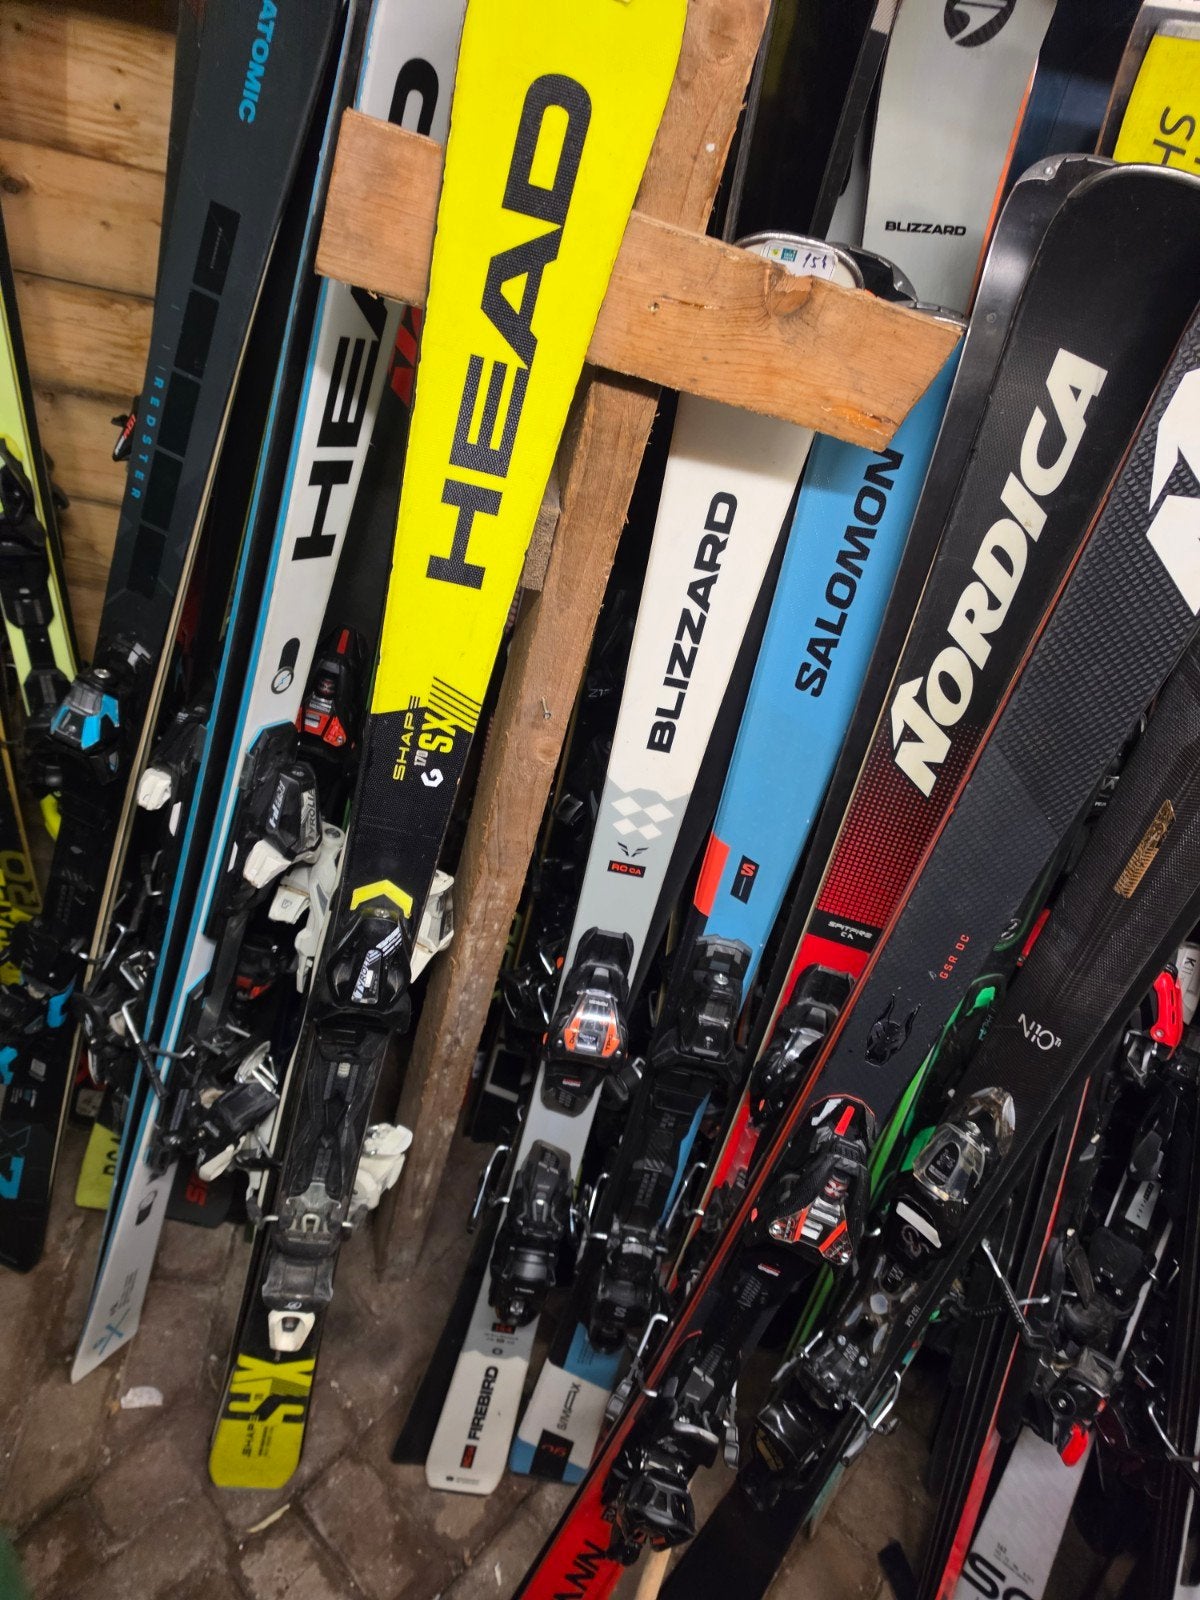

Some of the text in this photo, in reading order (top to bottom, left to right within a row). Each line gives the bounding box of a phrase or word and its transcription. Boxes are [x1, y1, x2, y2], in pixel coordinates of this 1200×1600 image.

[239, 0, 278, 124] ATOMIC
[885, 221, 967, 237] BLIZZARD
[426, 73, 592, 590] HEAD
[131, 376, 164, 499] REDSTER
[646, 491, 738, 754] BLIZZARD
[795, 449, 904, 697] SALOMON
[891, 348, 1108, 797] NORDICA
[393, 695, 420, 781] SHAPE
[418, 711, 474, 754] SX
[828, 920, 873, 939] SPITFIRE
[939, 955, 958, 980] GSR
[467, 1365, 499, 1441] FIREBIRD
